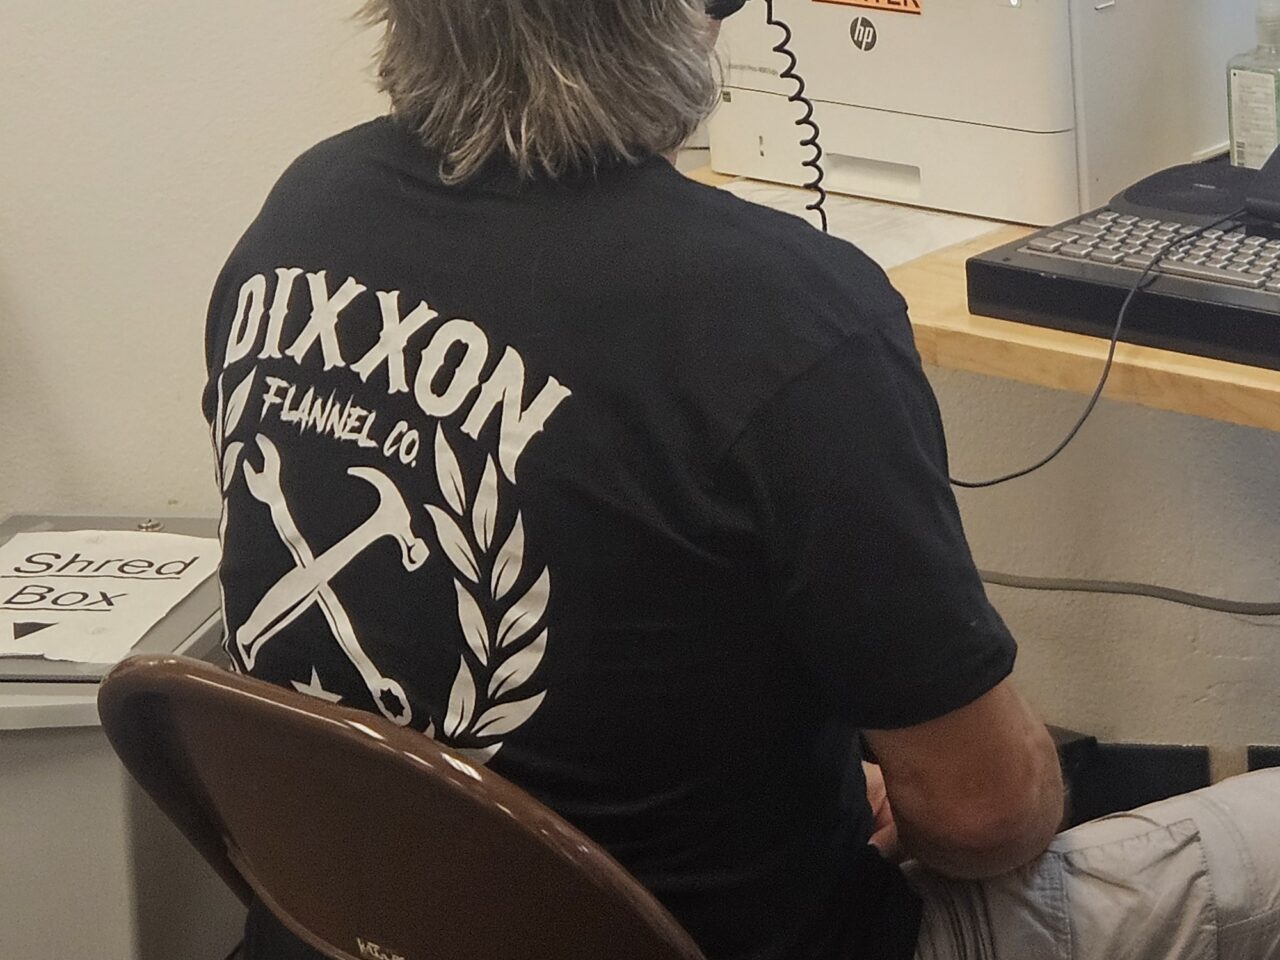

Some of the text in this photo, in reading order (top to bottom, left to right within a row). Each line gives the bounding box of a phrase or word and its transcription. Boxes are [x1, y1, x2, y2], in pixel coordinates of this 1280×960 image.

[852, 17, 876, 51] hp
[223, 267, 571, 485] DIXXON
[259, 376, 422, 467] FLANNEL CO.
[13, 552, 200, 576] Shred
[3, 584, 128, 607] Box
